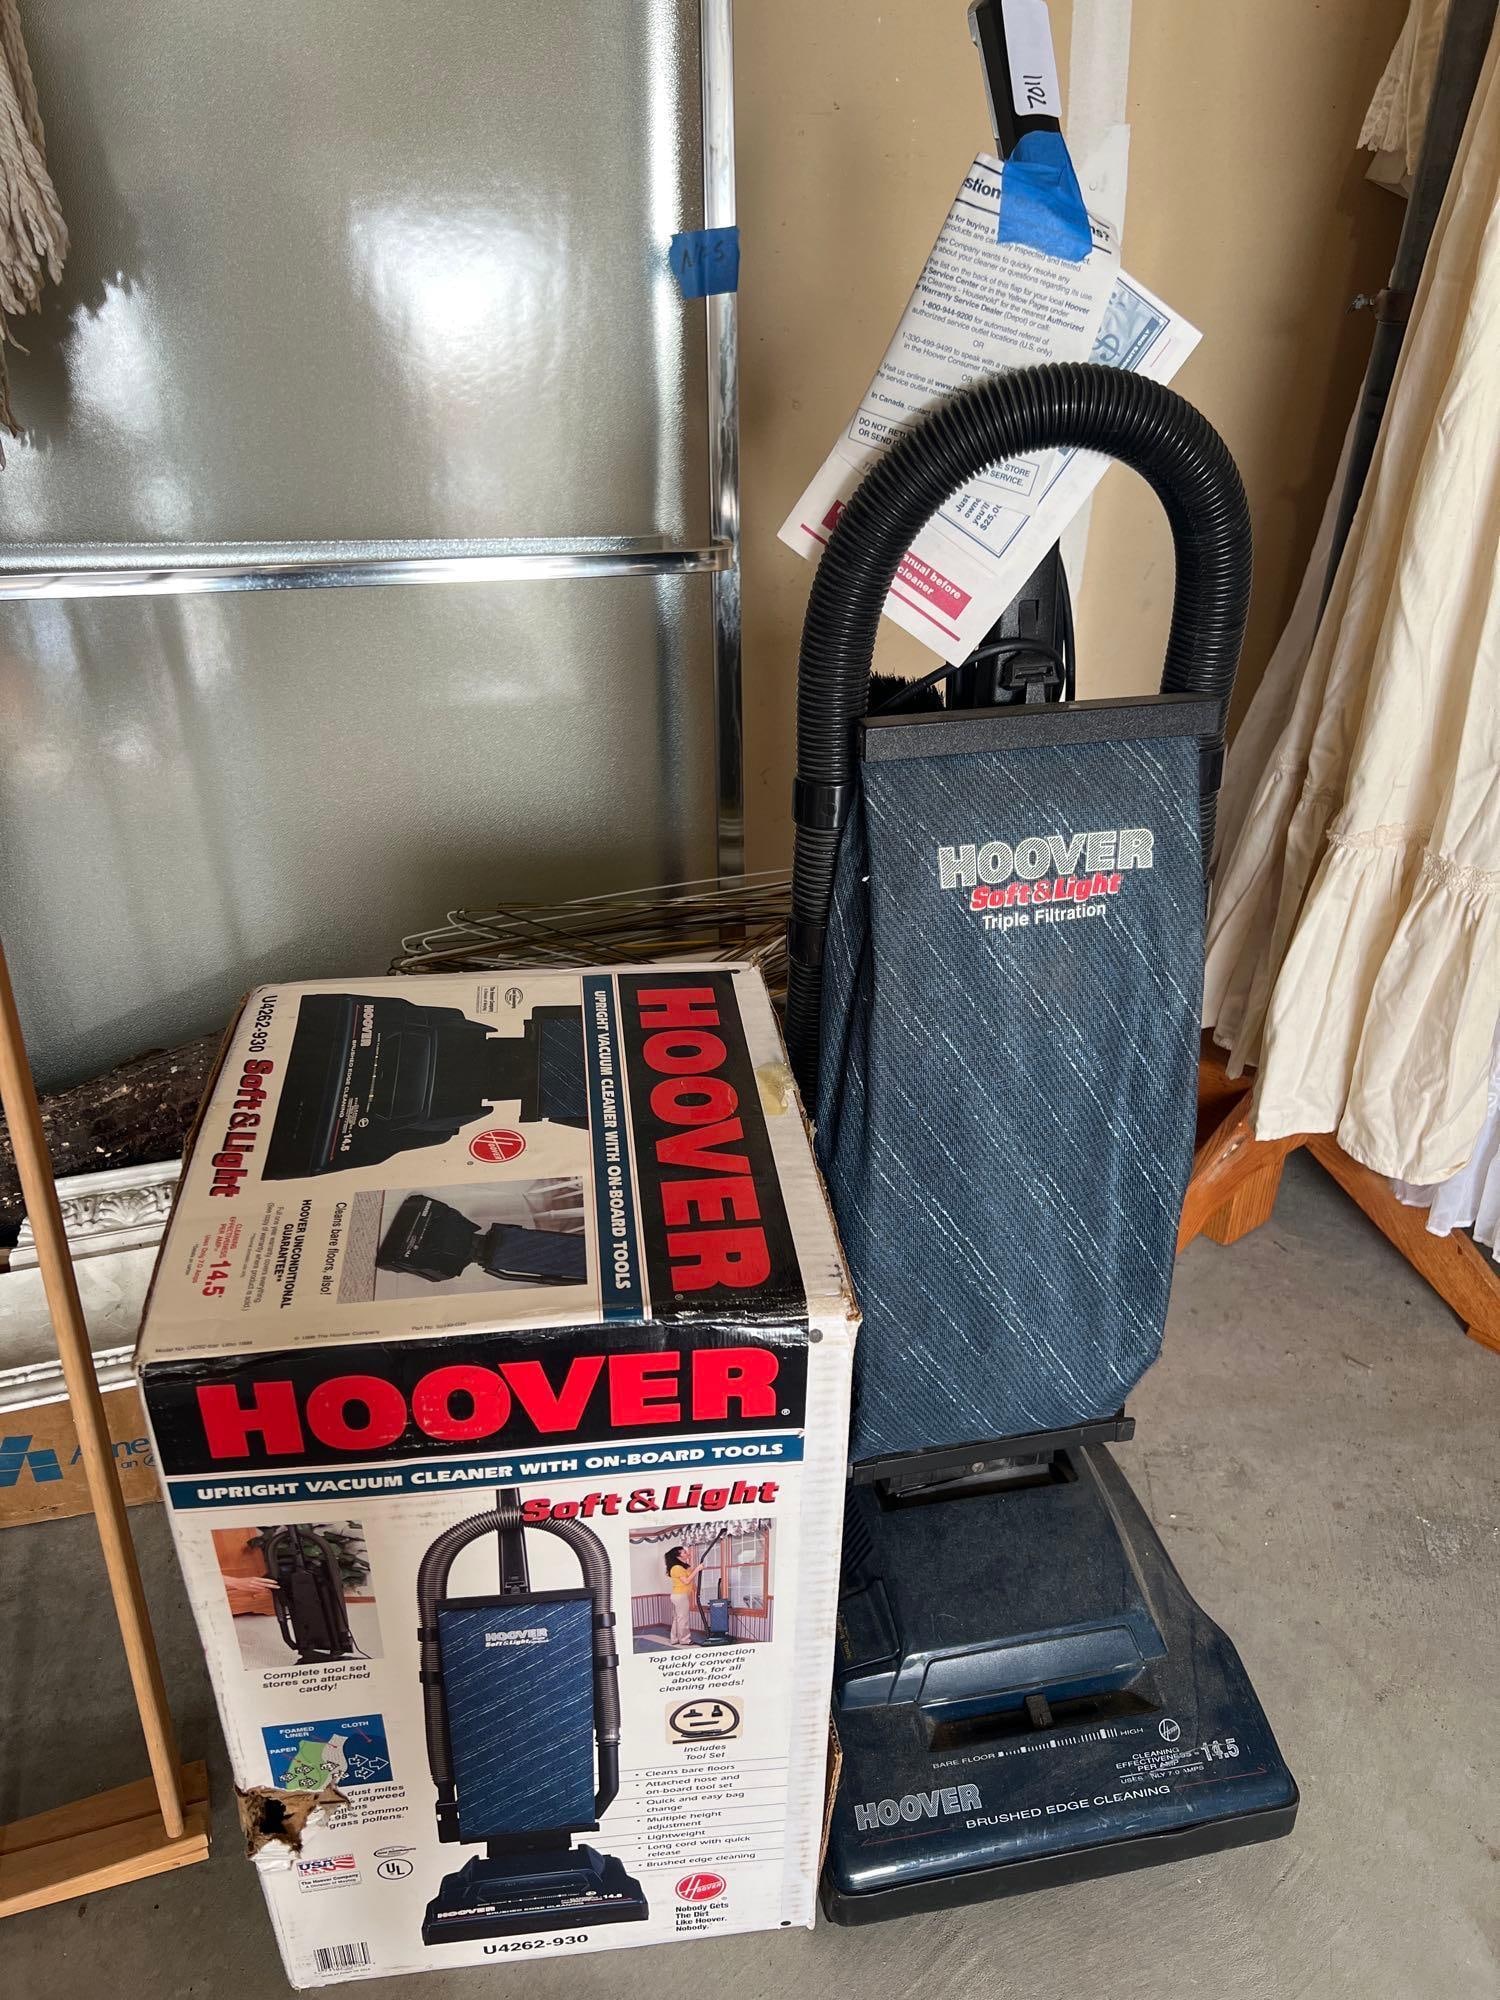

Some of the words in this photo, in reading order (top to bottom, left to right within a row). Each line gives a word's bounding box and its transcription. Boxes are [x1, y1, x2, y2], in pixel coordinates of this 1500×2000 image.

[1023, 75, 1046, 108] 7011
[962, 177, 1001, 199] stion
[927, 266, 954, 281] Service
[954, 275, 979, 289] Center
[921, 283, 953, 302] Warranty
[953, 294, 980, 309] Service
[980, 303, 1004, 316] Dealer
[1064, 300, 1090, 315] Hoover
[922, 299, 973, 322] 1-800-944-9200
[1046, 314, 1085, 333] Authorized
[858, 416, 871, 427] DO
[870, 421, 888, 433] NOT
[858, 427, 870, 438] OR
[870, 432, 892, 445] SEND
[1004, 464, 1030, 478] STORE
[956, 494, 971, 512] Just
[897, 565, 933, 596] cleaner
[902, 552, 931, 576] anual
[929, 571, 961, 599] before
[938, 828, 1154, 889] HOOVER
[982, 913, 1028, 933] Triple
[1034, 903, 1106, 925] Filtration
[594, 990, 609, 1031] UPRIGHT
[247, 995, 279, 1052] U4262-930
[360, 1004, 375, 1047] HOOVER
[597, 1032, 613, 1076] VACUUM
[600, 1078, 617, 1128] CLEANER
[604, 1130, 620, 1162] WITH
[636, 987, 772, 1291] HOOVER
[607, 1165, 626, 1237] ON-BOARD
[295, 1199, 312, 1233] HOOVER
[332, 1202, 348, 1227] Cleans
[328, 1228, 342, 1246] bare
[322, 1248, 339, 1273] floors,
[613, 1240, 631, 1289] TOOLS
[280, 1234, 305, 1309] UNCONDITIONAL
[319, 1275, 334, 1295] also!
[195, 1347, 781, 1460] HOOVER
[197, 1482, 299, 1500] UPRIGHT
[304, 1474, 403, 1492] VACUUM
[410, 1465, 513, 1484] CLEANER
[519, 1458, 578, 1475] WITH
[584, 1448, 705, 1469] ON-BOARD
[711, 1443, 783, 1458] TOOLS
[485, 1628, 548, 1642] HOOVER
[648, 1656, 668, 1664] Top
[670, 1652, 692, 1661] tool
[694, 1648, 756, 1659] connection
[657, 1660, 697, 1671] quickly
[699, 1656, 745, 1666] converts
[263, 1668, 320, 1680] Complete
[323, 1665, 346, 1674] tool
[349, 1664, 366, 1672] set
[662, 1668, 707, 1677] vacuum,
[728, 1663, 742, 1671] all
[262, 1680, 298, 1688] stores
[320, 1671, 370, 1682] attached
[658, 1683, 705, 1692] cleaning
[708, 1678, 744, 1688] needs!
[671, 1673, 732, 1684] above-floor
[298, 1682, 337, 1693] caddy!
[279, 1726, 314, 1736] FOAMED
[341, 1720, 369, 1729] CLOTH
[1120, 1728, 1144, 1736] HIGH
[270, 1746, 297, 1754] PAPER
[683, 1744, 726, 1752] Includes
[685, 1752, 706, 1760] Tool
[708, 1751, 725, 1759] Set
[1132, 1747, 1180, 1760] CLEANING
[932, 1759, 960, 1769] BARE
[961, 1753, 996, 1764] FLOOR
[1138, 1764, 1157, 1772] PER
[645, 1769, 678, 1777] Cleans
[347, 1788, 370, 1796] dust
[374, 1785, 404, 1793] mites
[645, 1778, 691, 1787] Attached
[645, 1785, 692, 1795] on-board
[358, 1792, 406, 1802] ragweed
[646, 1797, 676, 1805] Quick
[329, 1812, 358, 1821] .98%
[362, 1805, 408, 1816] common
[646, 1805, 683, 1813] change
[854, 1784, 982, 1831] HOOVER
[965, 1807, 1042, 1829] BRUSHED
[1045, 1798, 1090, 1814] EDGE
[1093, 1785, 1170, 1806] CLEANING
[328, 1819, 359, 1830] grass
[362, 1814, 404, 1824] pollens.
[646, 1814, 687, 1823] Multiple
[689, 1811, 721, 1819] height
[646, 1820, 701, 1830] adjustment
[647, 1830, 705, 1840] Lightweight
[724, 1835, 750, 1844] quick
[298, 1860, 334, 1872] USA
[646, 1858, 686, 1867] Brushed
[715, 1853, 756, 1861] cleaning
[386, 1862, 405, 1876] UL
[437, 1906, 496, 1918] HOOVER
[675, 1904, 707, 1912] Nobody
[693, 1910, 709, 1918] Dirt
[675, 1924, 709, 1932] Nobody.
[695, 1916, 727, 1924] Hoover.
[483, 1934, 588, 1955] U4262-930
